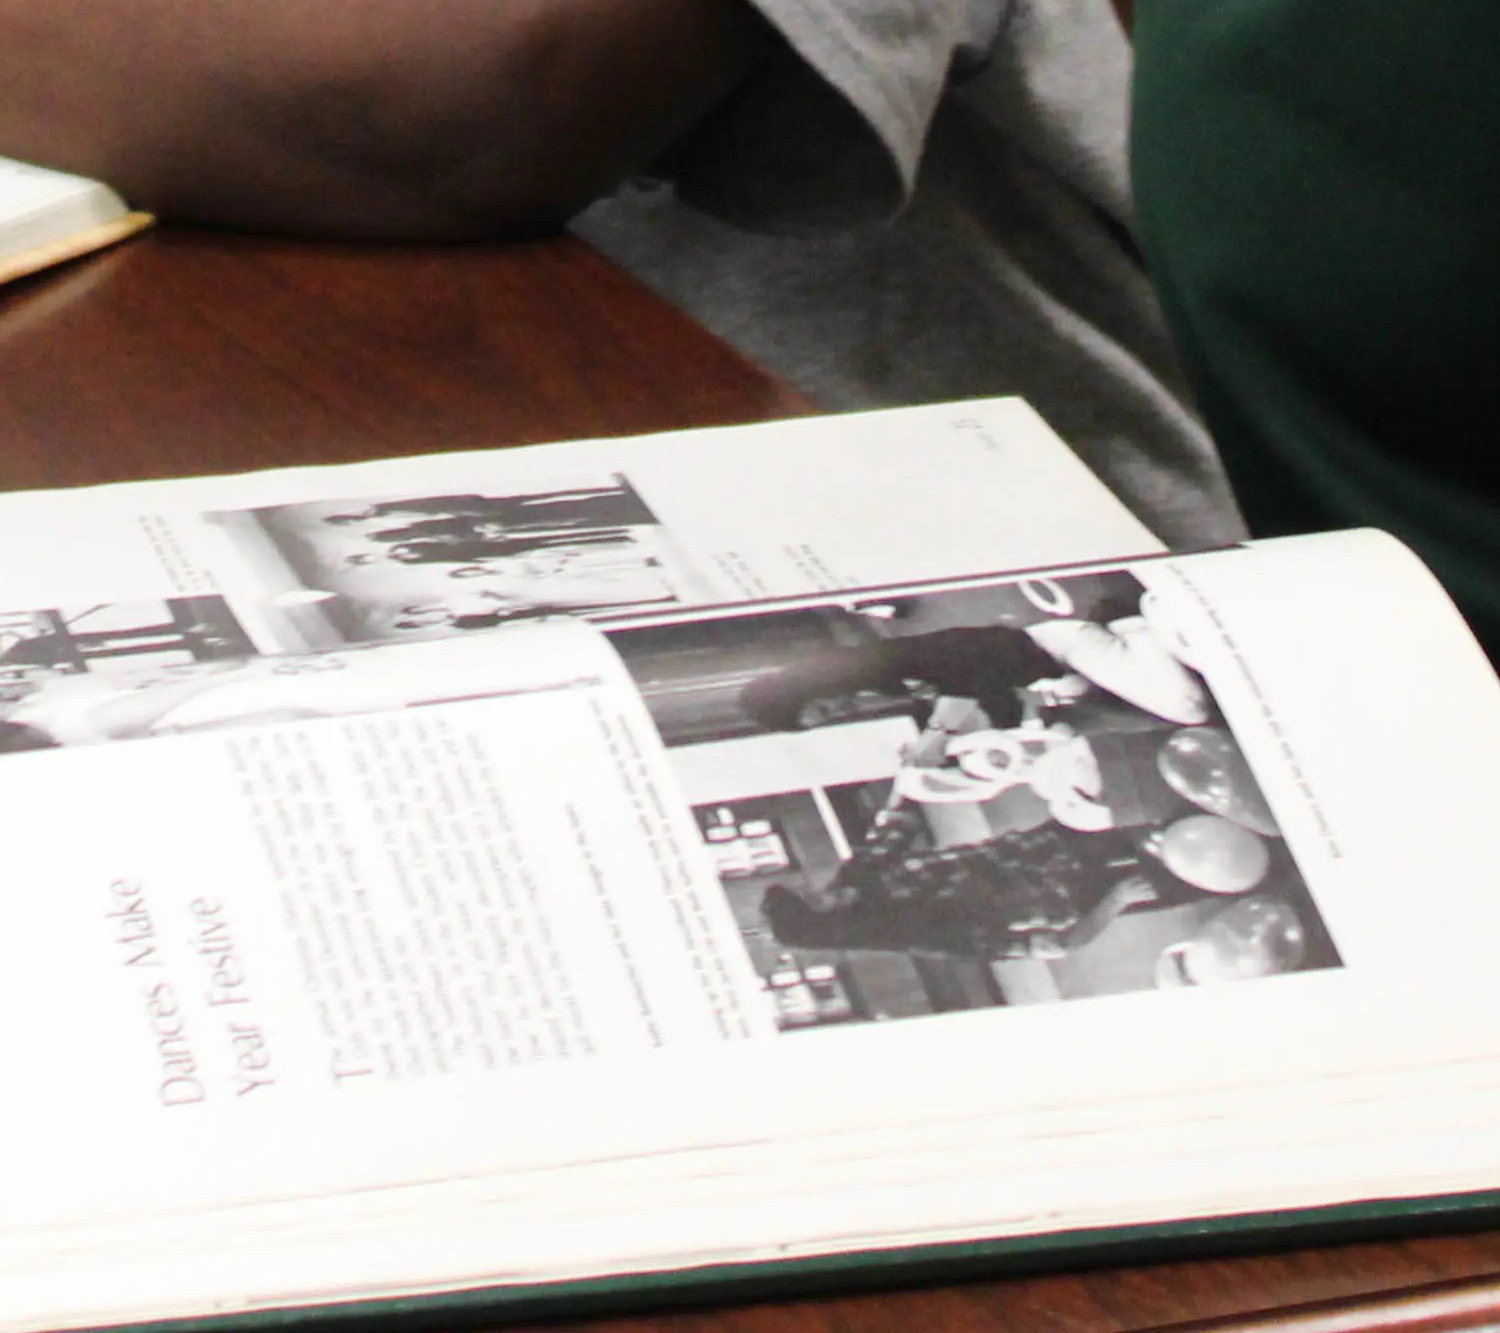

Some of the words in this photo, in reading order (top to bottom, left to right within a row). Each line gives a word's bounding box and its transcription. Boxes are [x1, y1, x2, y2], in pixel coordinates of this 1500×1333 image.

[104, 879, 164, 967] Make
[188, 896, 252, 1007] Festive
[145, 980, 206, 1107] Dances
[228, 1023, 276, 1097] Year
